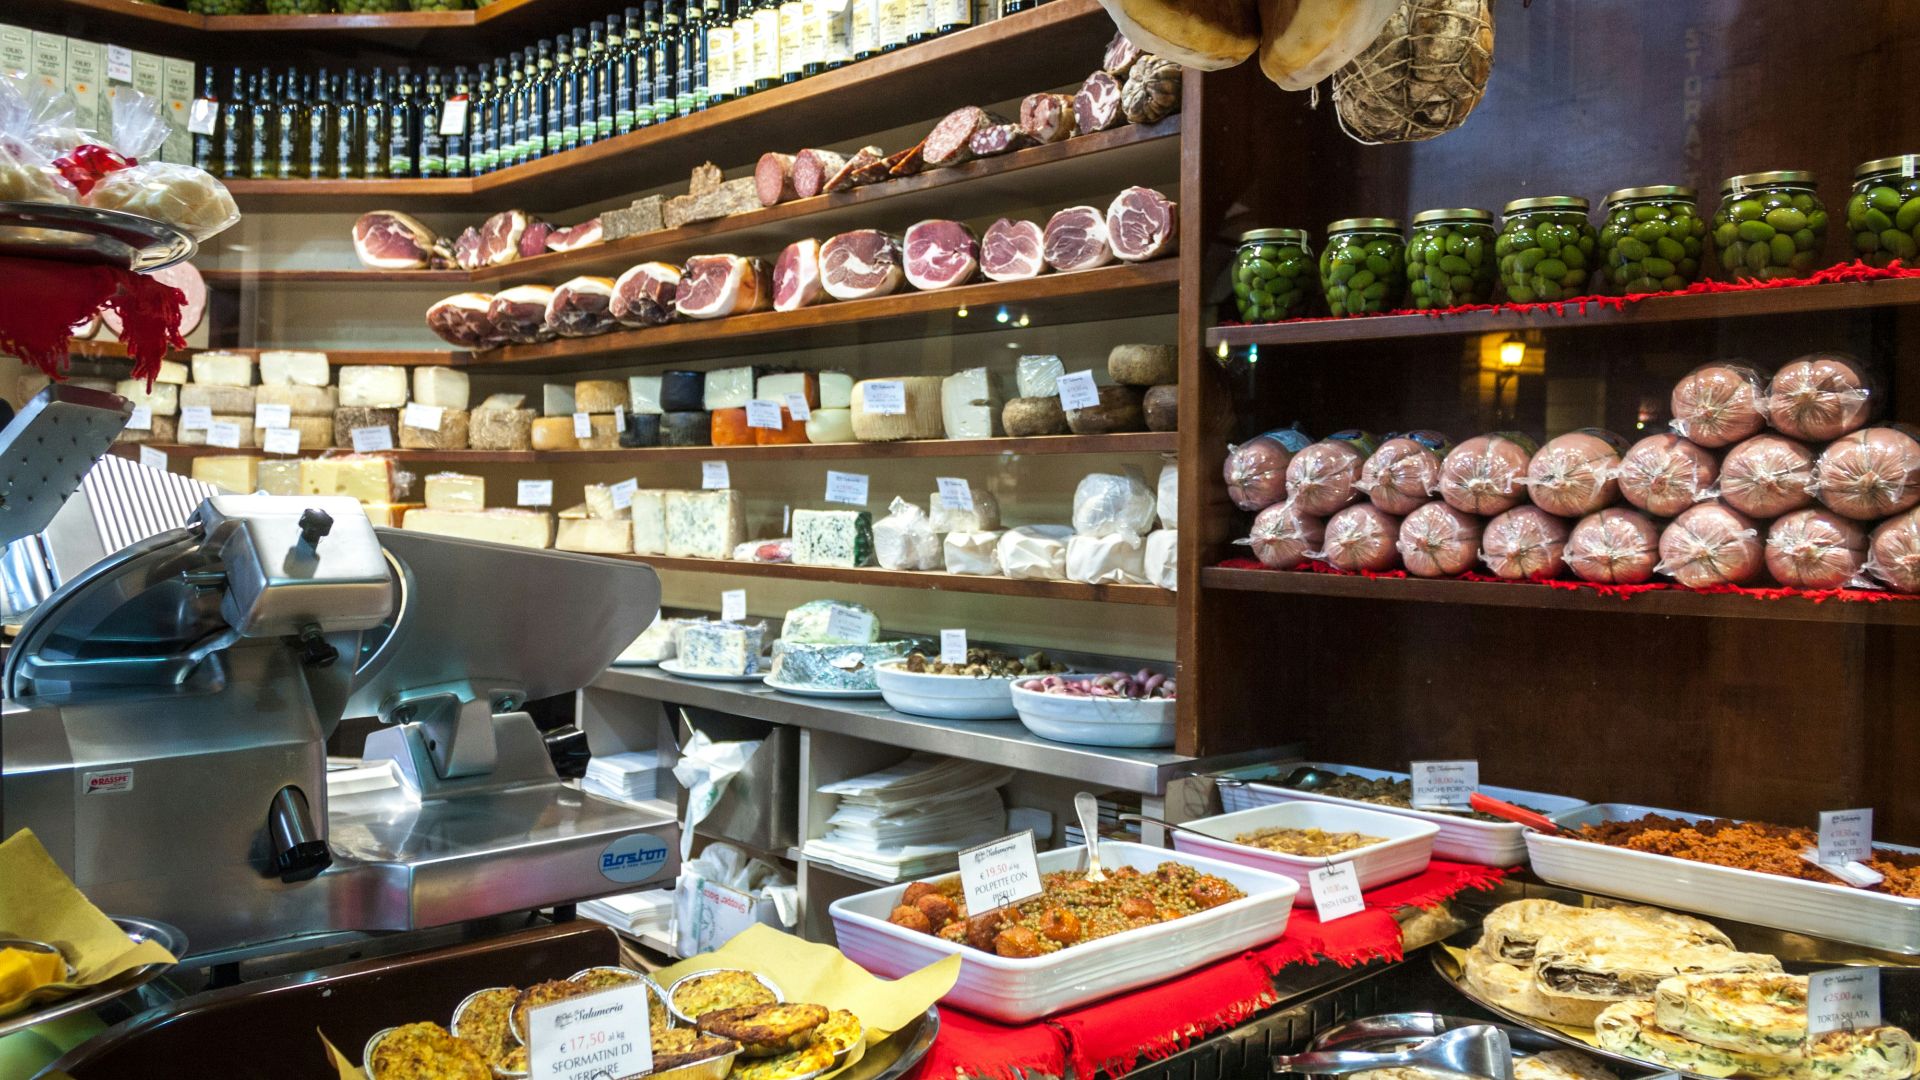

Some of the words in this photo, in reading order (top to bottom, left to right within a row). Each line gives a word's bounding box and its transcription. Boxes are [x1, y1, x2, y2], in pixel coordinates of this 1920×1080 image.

[603, 848, 667, 867] Boston
[975, 877, 1009, 895] POLPETTE
[1010, 871, 1028, 884] CON
[575, 1003, 623, 1021] Salumeria
[1817, 1012, 1839, 1024] TORTA
[1841, 1010, 1869, 1020] SALATA
[560, 1043, 567, 1053] €
[569, 1030, 606, 1051] 17,50
[607, 1032, 615, 1041] al
[615, 1031, 625, 1041] kg
[552, 1048, 618, 1074] SFORMATINI
[621, 1043, 632, 1055] DI
